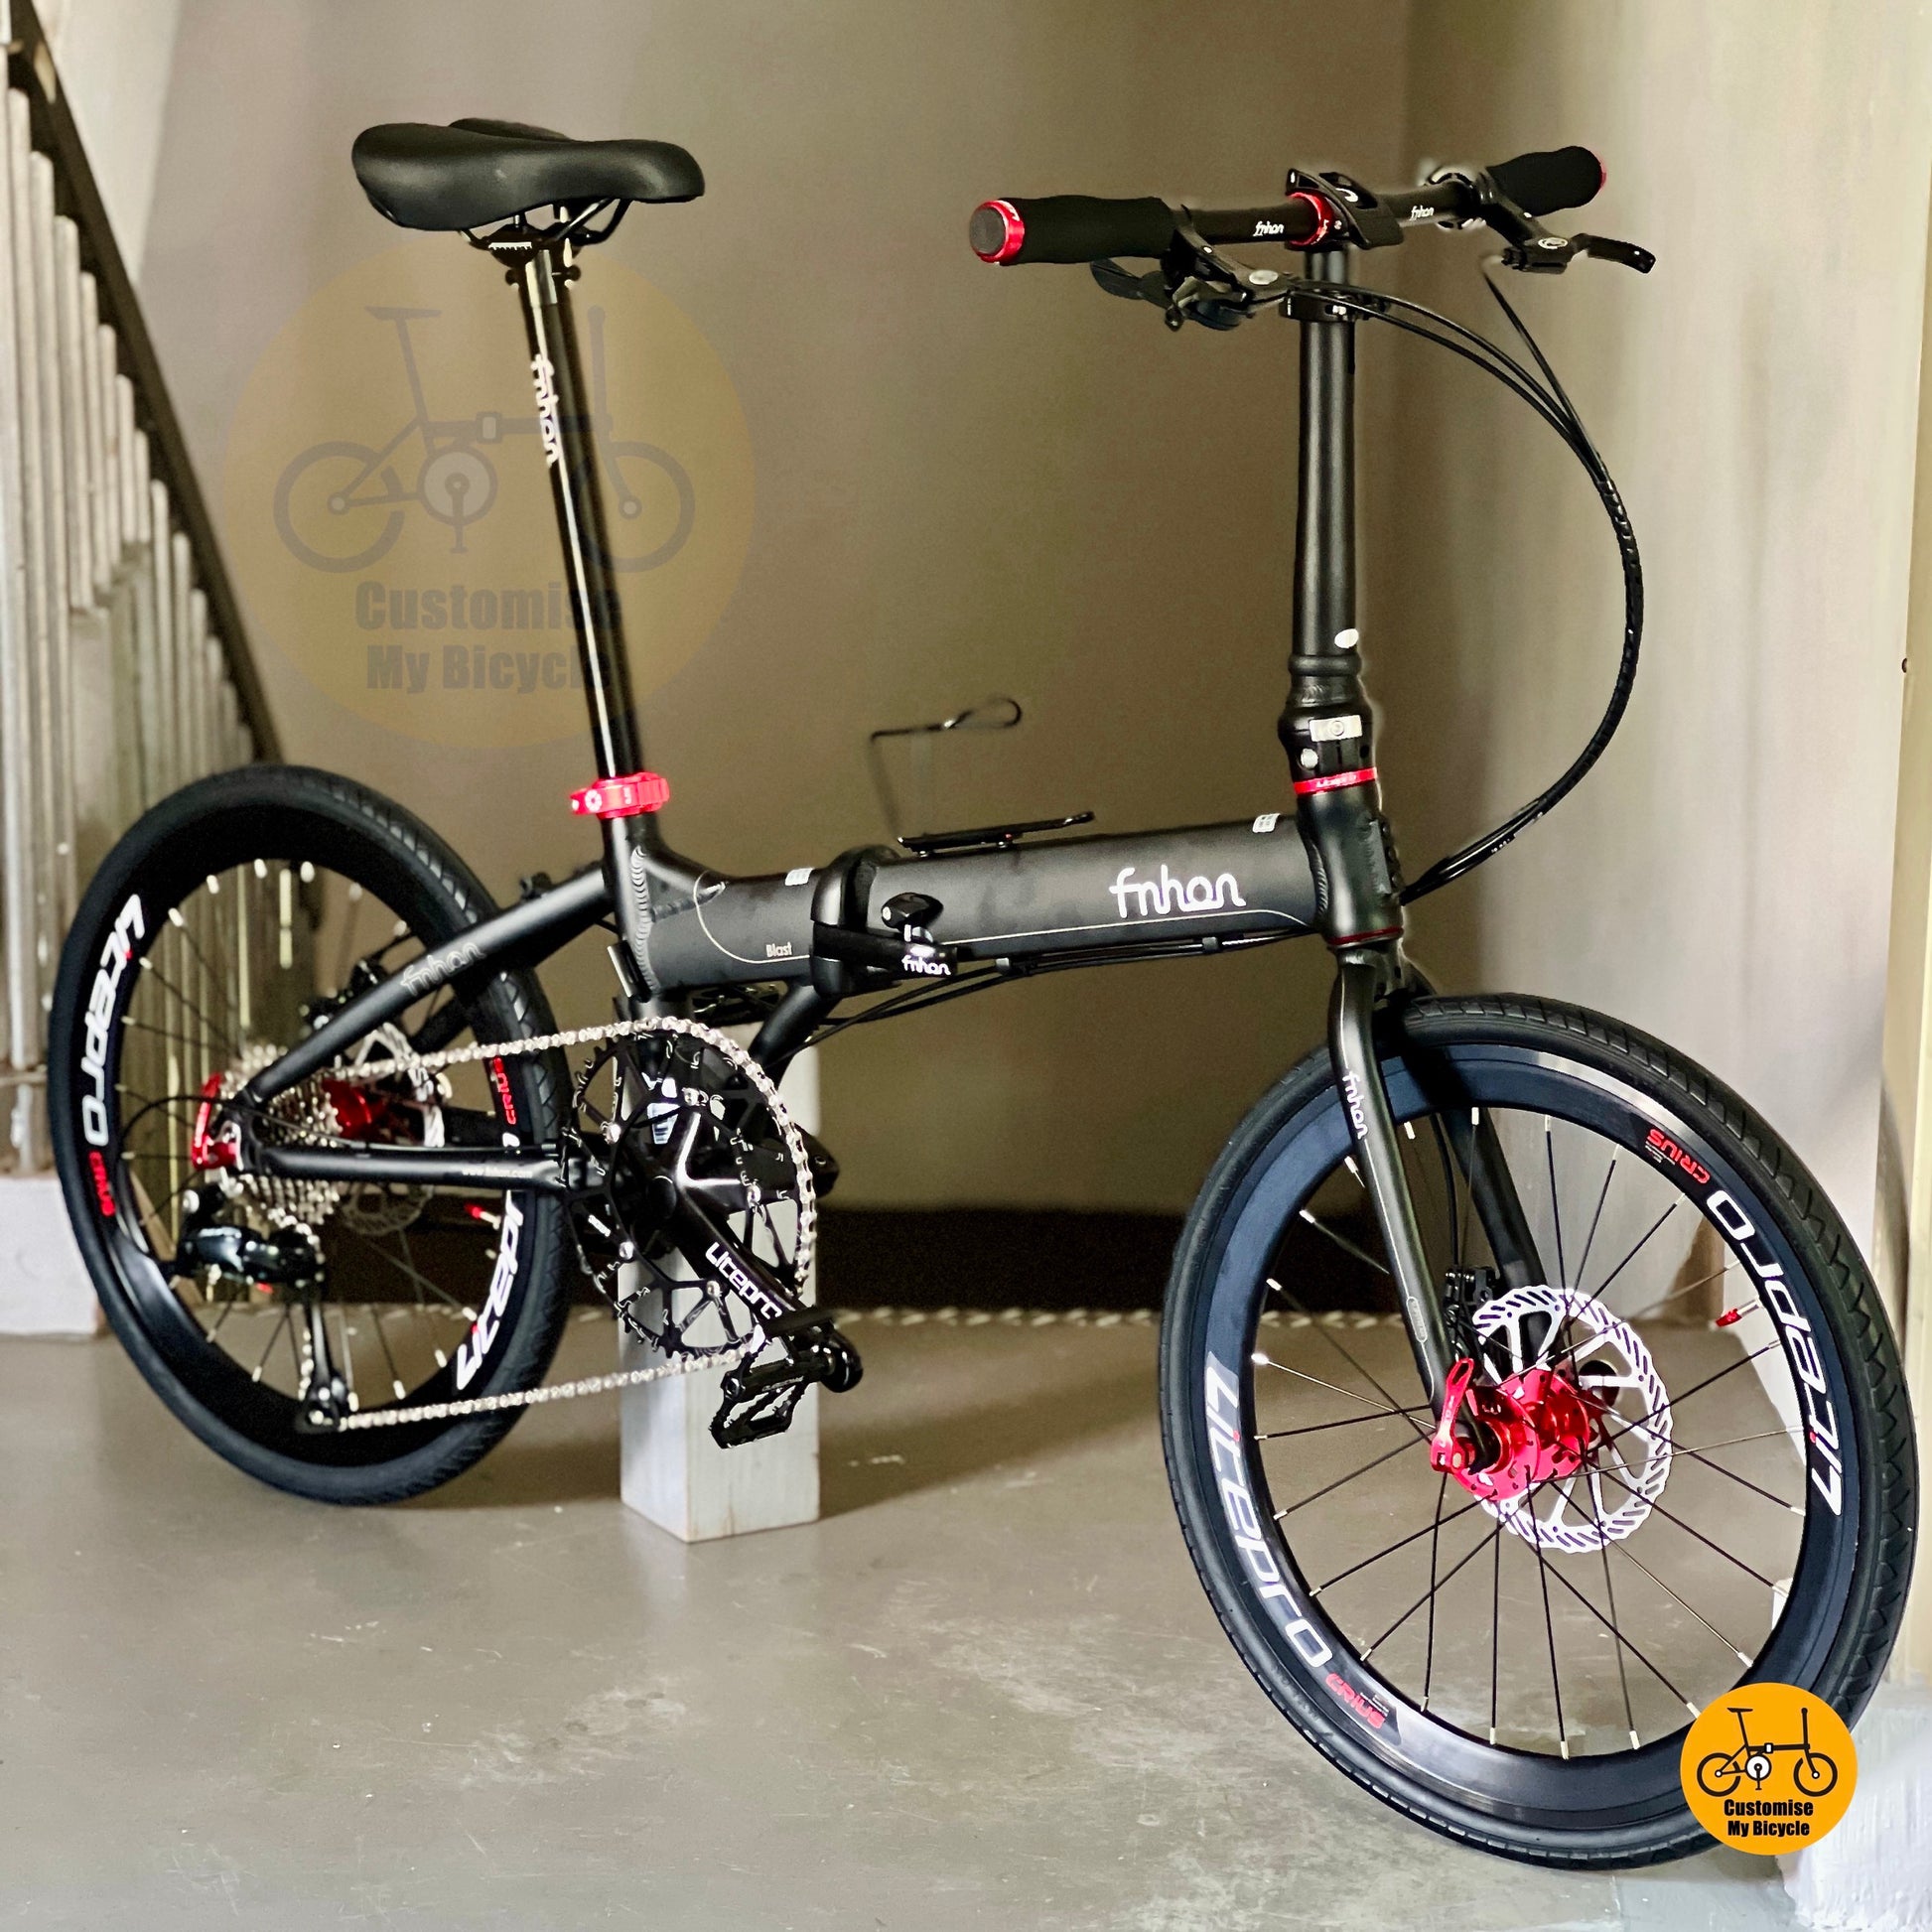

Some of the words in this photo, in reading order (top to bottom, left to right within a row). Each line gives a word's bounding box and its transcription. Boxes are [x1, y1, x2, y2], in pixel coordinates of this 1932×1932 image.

[1253, 220, 1285, 237] fnhon
[1410, 205, 1434, 220] fnhon
[530, 353, 562, 468] fnhon
[1108, 864, 1247, 919] fnhon
[400, 942, 486, 997] fnhon
[765, 941, 792, 958] Blast
[901, 954, 951, 976] fnhon
[1341, 1070, 1368, 1140] fnhon
[1646, 1128, 1712, 1184] CRIUS
[1325, 1672, 1386, 1729] CRIUS
